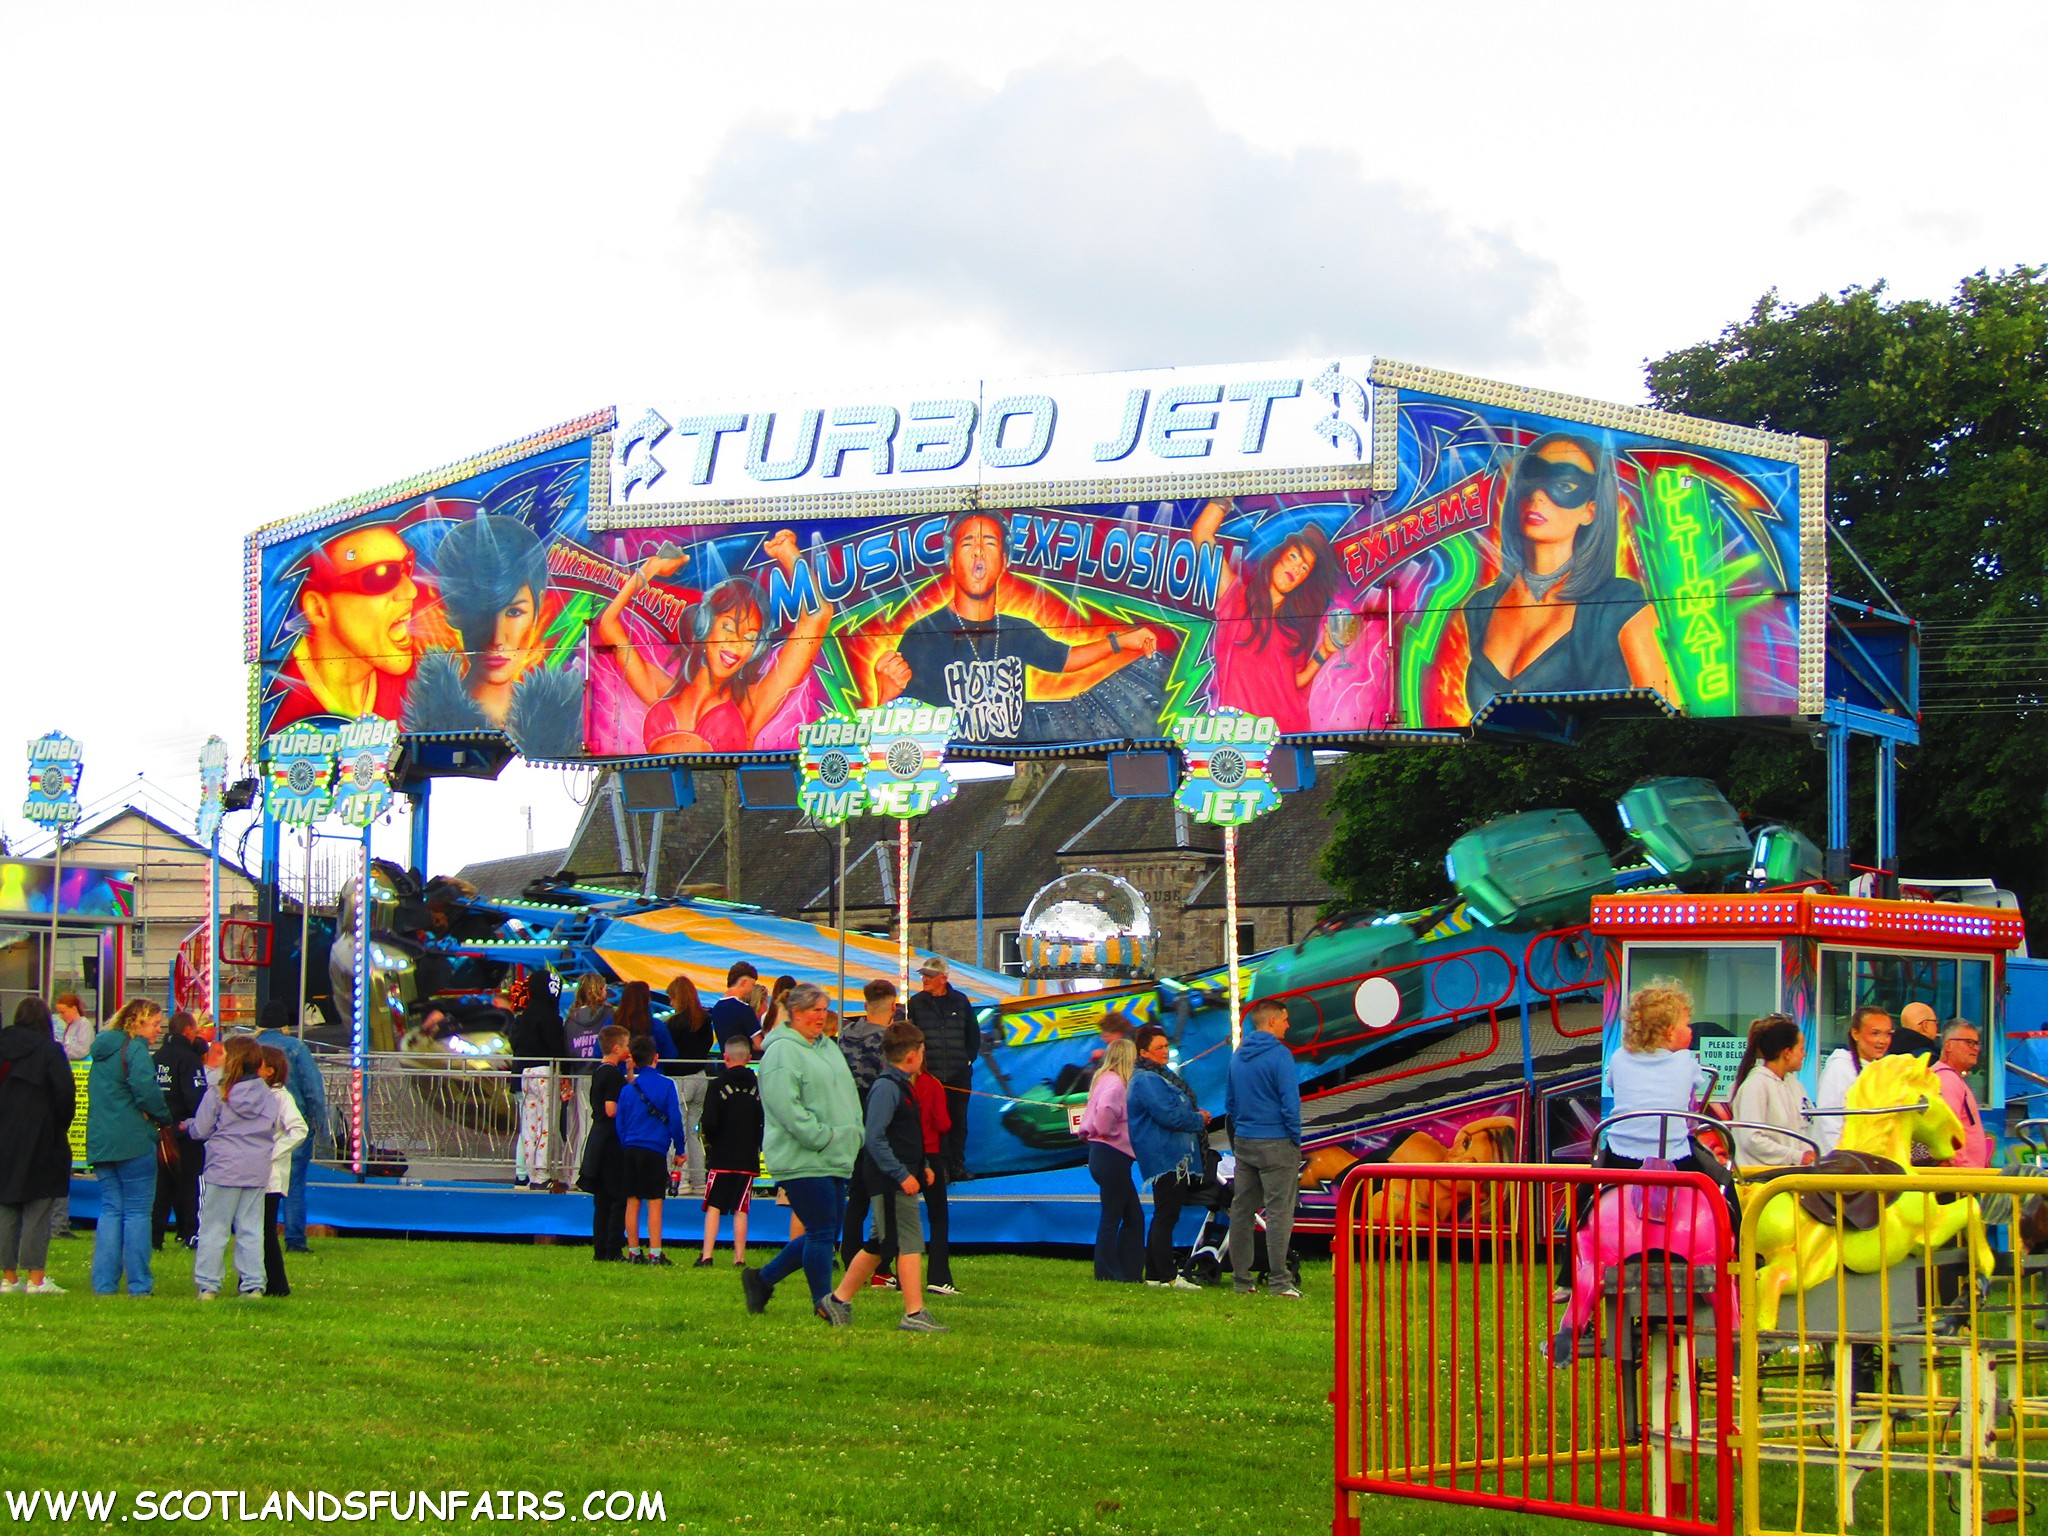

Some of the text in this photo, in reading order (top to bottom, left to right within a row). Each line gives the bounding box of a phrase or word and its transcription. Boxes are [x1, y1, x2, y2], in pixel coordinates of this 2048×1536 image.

[676, 378, 1303, 485] TURBO JET
[1343, 482, 1484, 586] EXTREME
[768, 513, 1223, 631] MUSIC EXPLOSION
[1656, 467, 1729, 702] ULTIMATE
[633, 585, 687, 633] RUSH
[944, 655, 1022, 704] HOUSE
[856, 707, 956, 734] TURBO
[1178, 717, 1276, 743] TURBO
[269, 734, 337, 755] TURBO
[339, 720, 399, 748] TURBO
[799, 724, 871, 747] TURBO
[27, 740, 83, 761] TURBO
[23, 802, 80, 820] POWER
[271, 798, 334, 822] TIME
[342, 793, 382, 825] JET
[802, 791, 867, 817] TIME
[870, 782, 938, 815] JET
[1195, 791, 1262, 823] JET
[1144, 890, 1182, 902] OUSE
[573, 1034, 599, 1048] WHIT
[581, 1046, 594, 1058] FO
[1708, 1041, 1735, 1049] PLEASE
[1704, 1051, 1744, 1059] YOUR BELO
